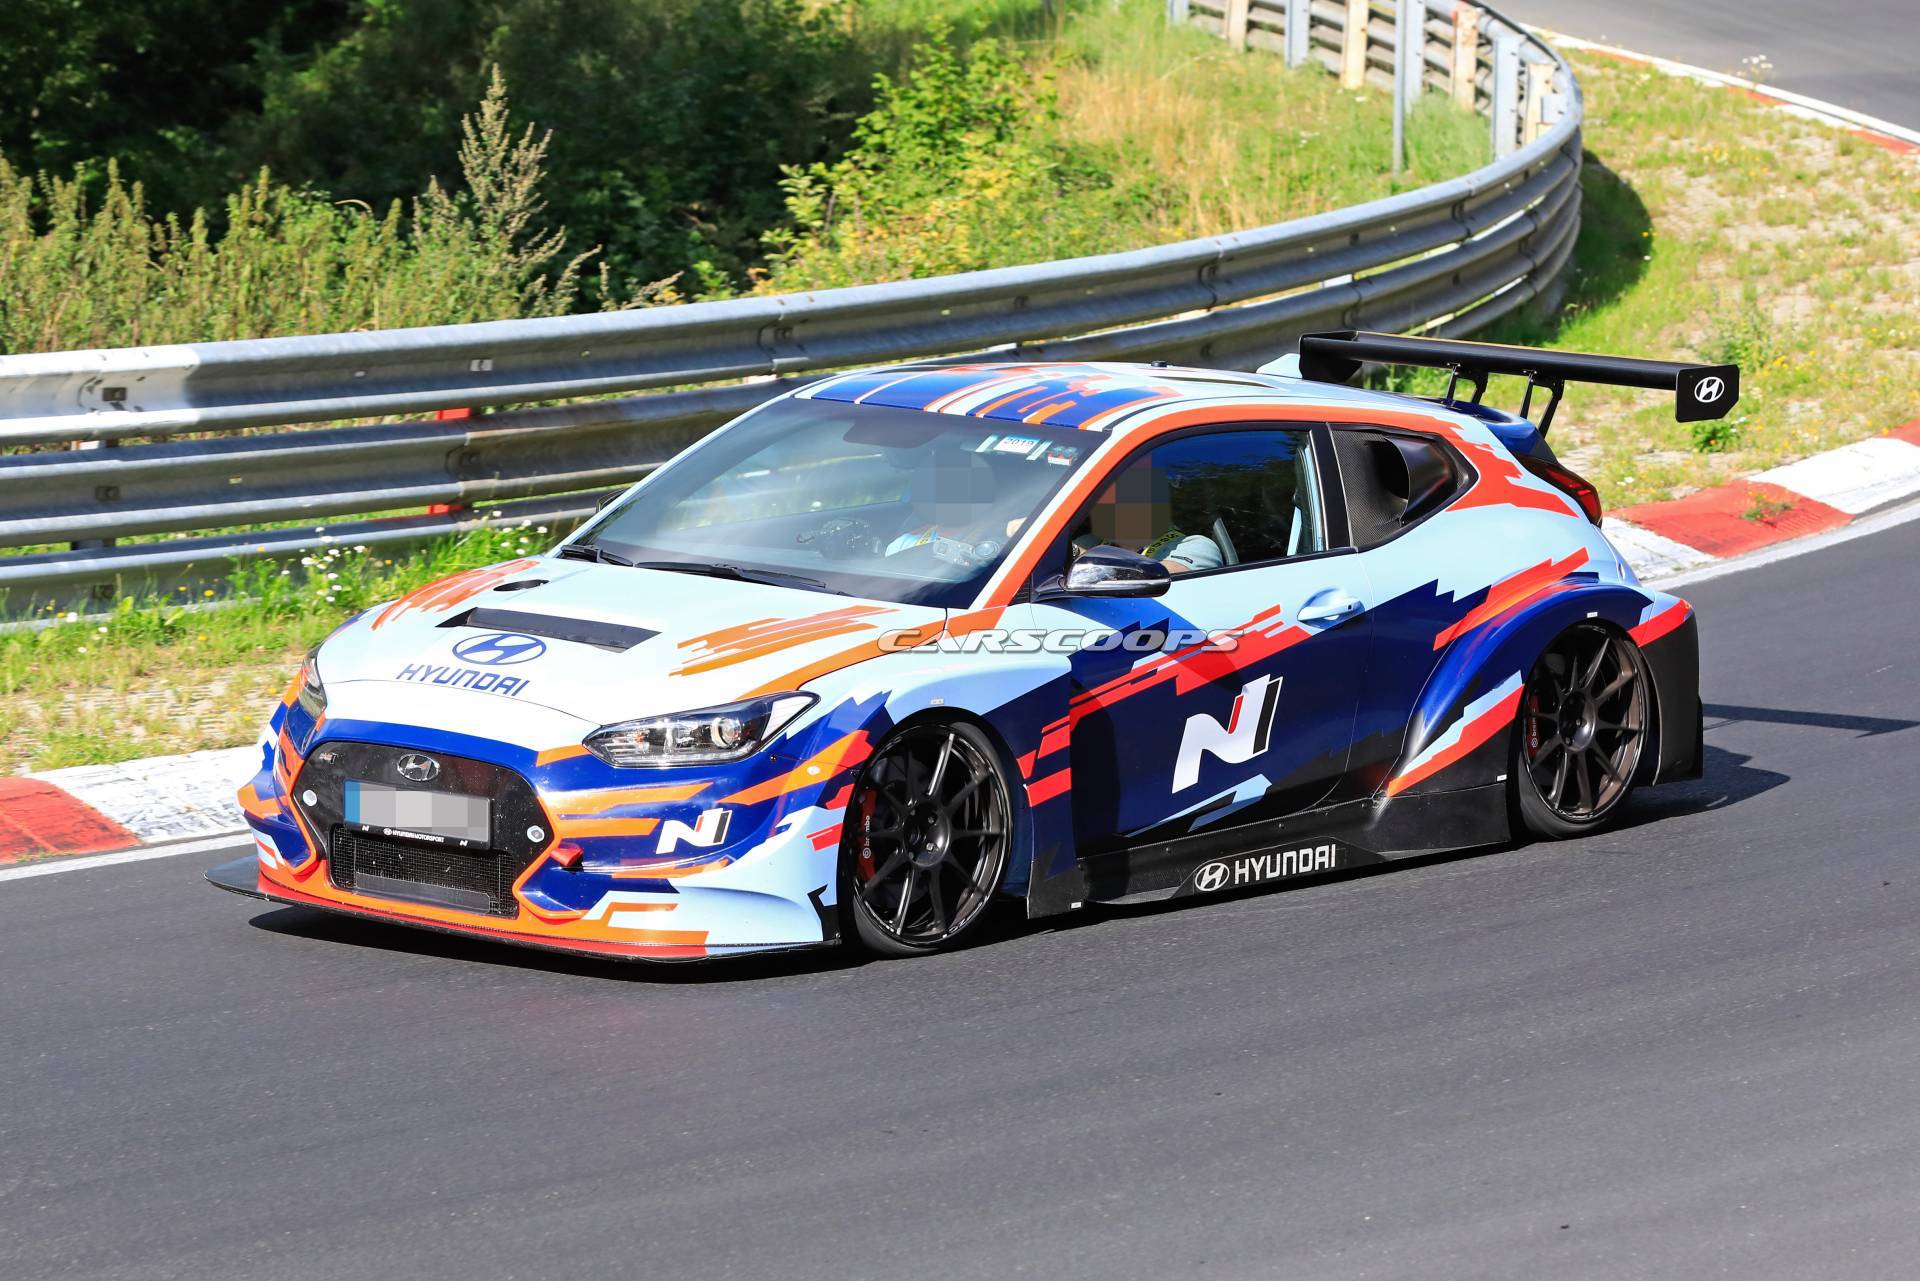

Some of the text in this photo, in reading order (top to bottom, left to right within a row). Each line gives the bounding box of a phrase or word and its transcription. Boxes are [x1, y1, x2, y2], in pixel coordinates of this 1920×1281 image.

[396, 663, 531, 697] HYUNDAI
[1171, 673, 1284, 794] N
[655, 807, 733, 855] N
[1234, 843, 1337, 885] HYUNDAI
